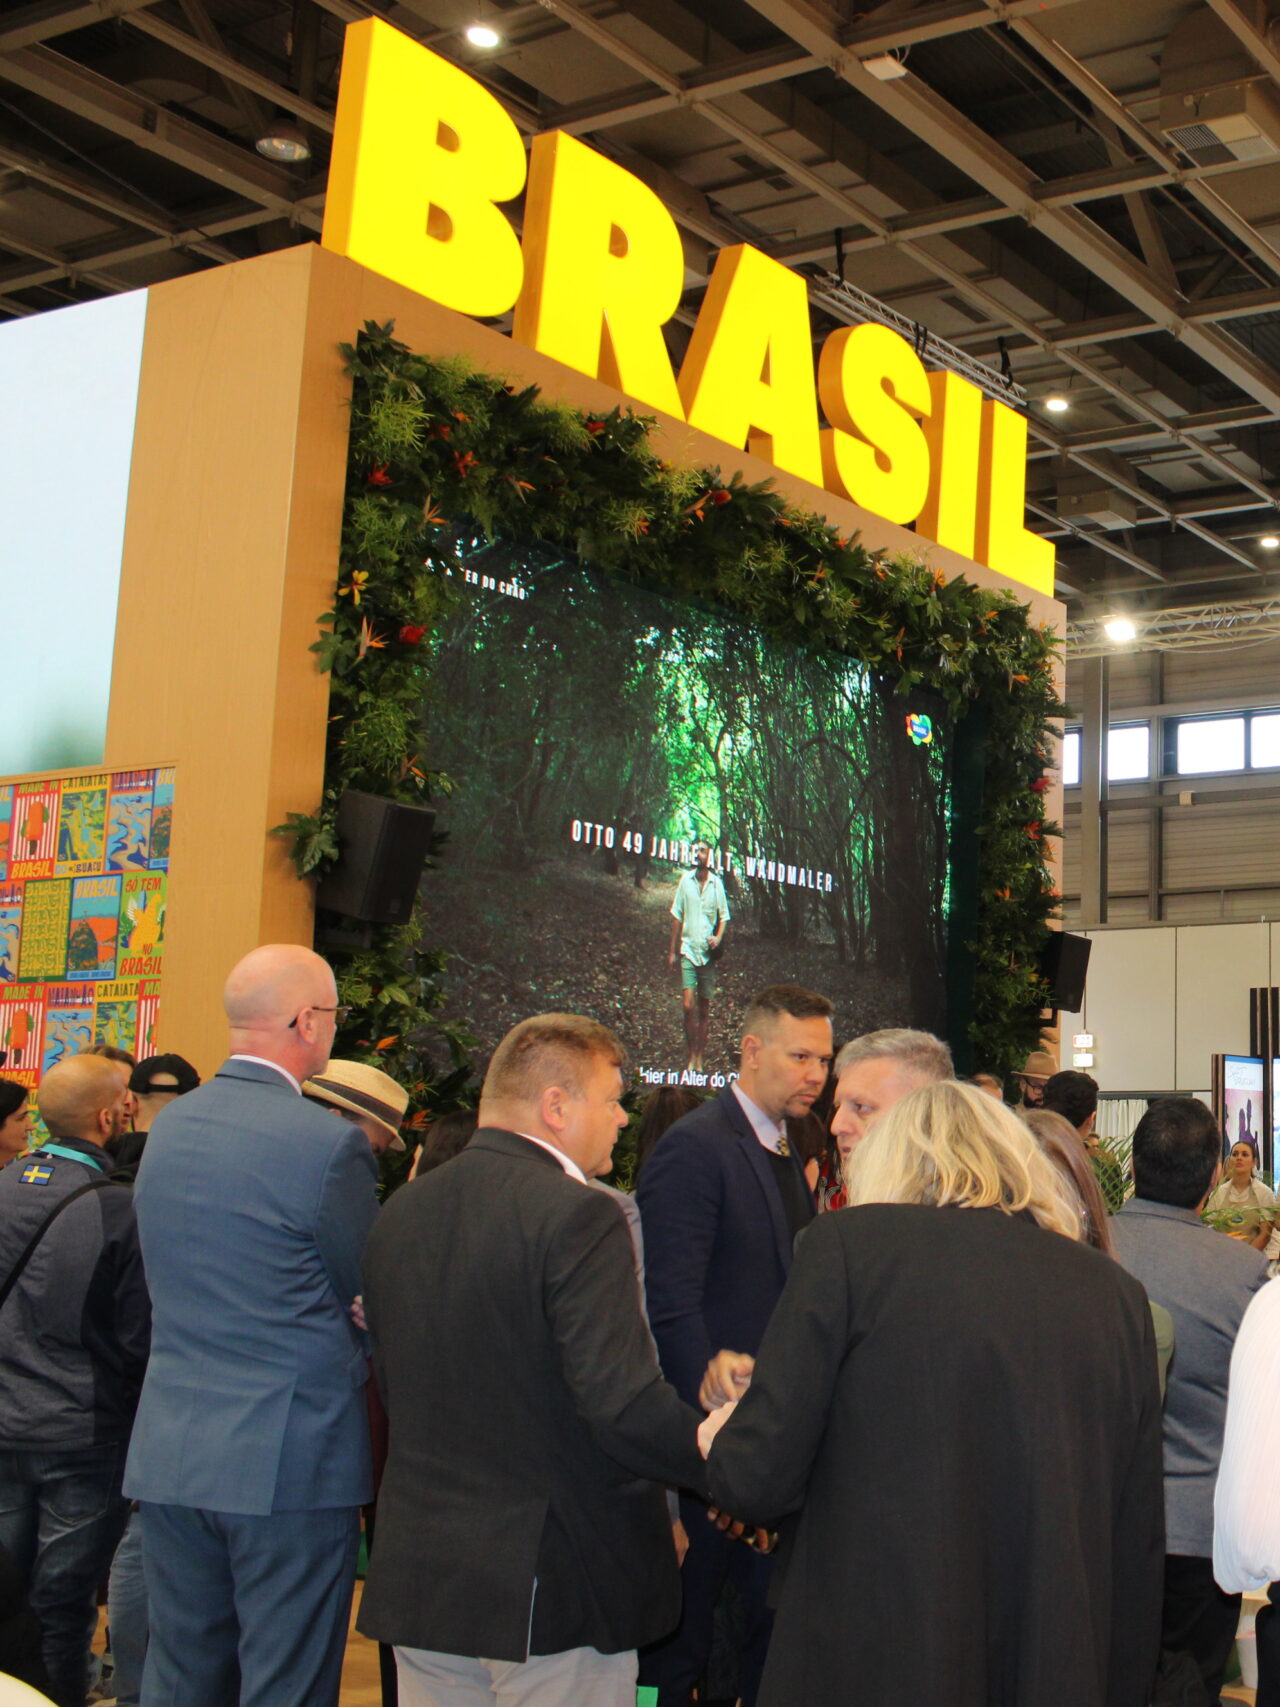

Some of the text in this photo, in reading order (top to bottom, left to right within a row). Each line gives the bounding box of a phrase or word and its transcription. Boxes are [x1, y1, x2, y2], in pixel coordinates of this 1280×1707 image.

[322, 16, 1057, 598] BRASIL
[482, 575, 496, 590] DO
[571, 819, 615, 849] OTTO
[622, 831, 643, 855] 49
[650, 836, 699, 866] JAHRE
[746, 856, 833, 892] WANDMALER
[11, 860, 51, 879] BRASIL
[74, 878, 119, 899] BRASIL
[125, 877, 162, 893] SÓ TEM
[119, 956, 162, 977] BRASIL
[3, 985, 45, 1000] MADE IN
[668, 1068, 679, 1085] in
[680, 1069, 708, 1087] Alter
[710, 1071, 725, 1088] do
